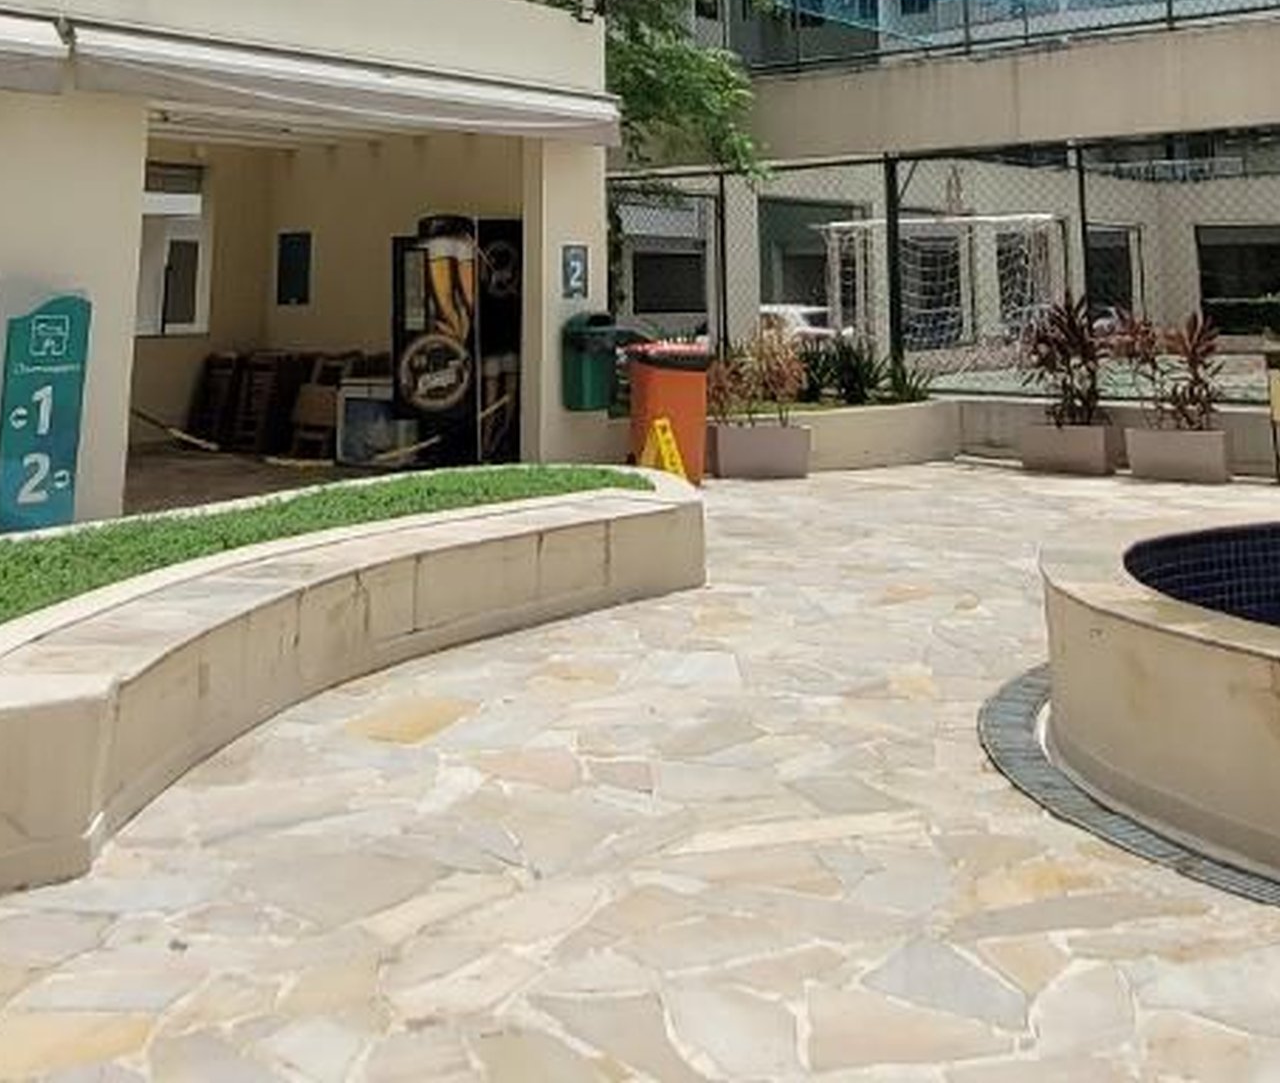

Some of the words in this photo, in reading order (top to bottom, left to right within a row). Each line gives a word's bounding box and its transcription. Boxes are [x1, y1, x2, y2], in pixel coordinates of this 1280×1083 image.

[569, 260, 583, 287] 2
[32, 385, 54, 435] 1
[17, 452, 51, 504] 2
